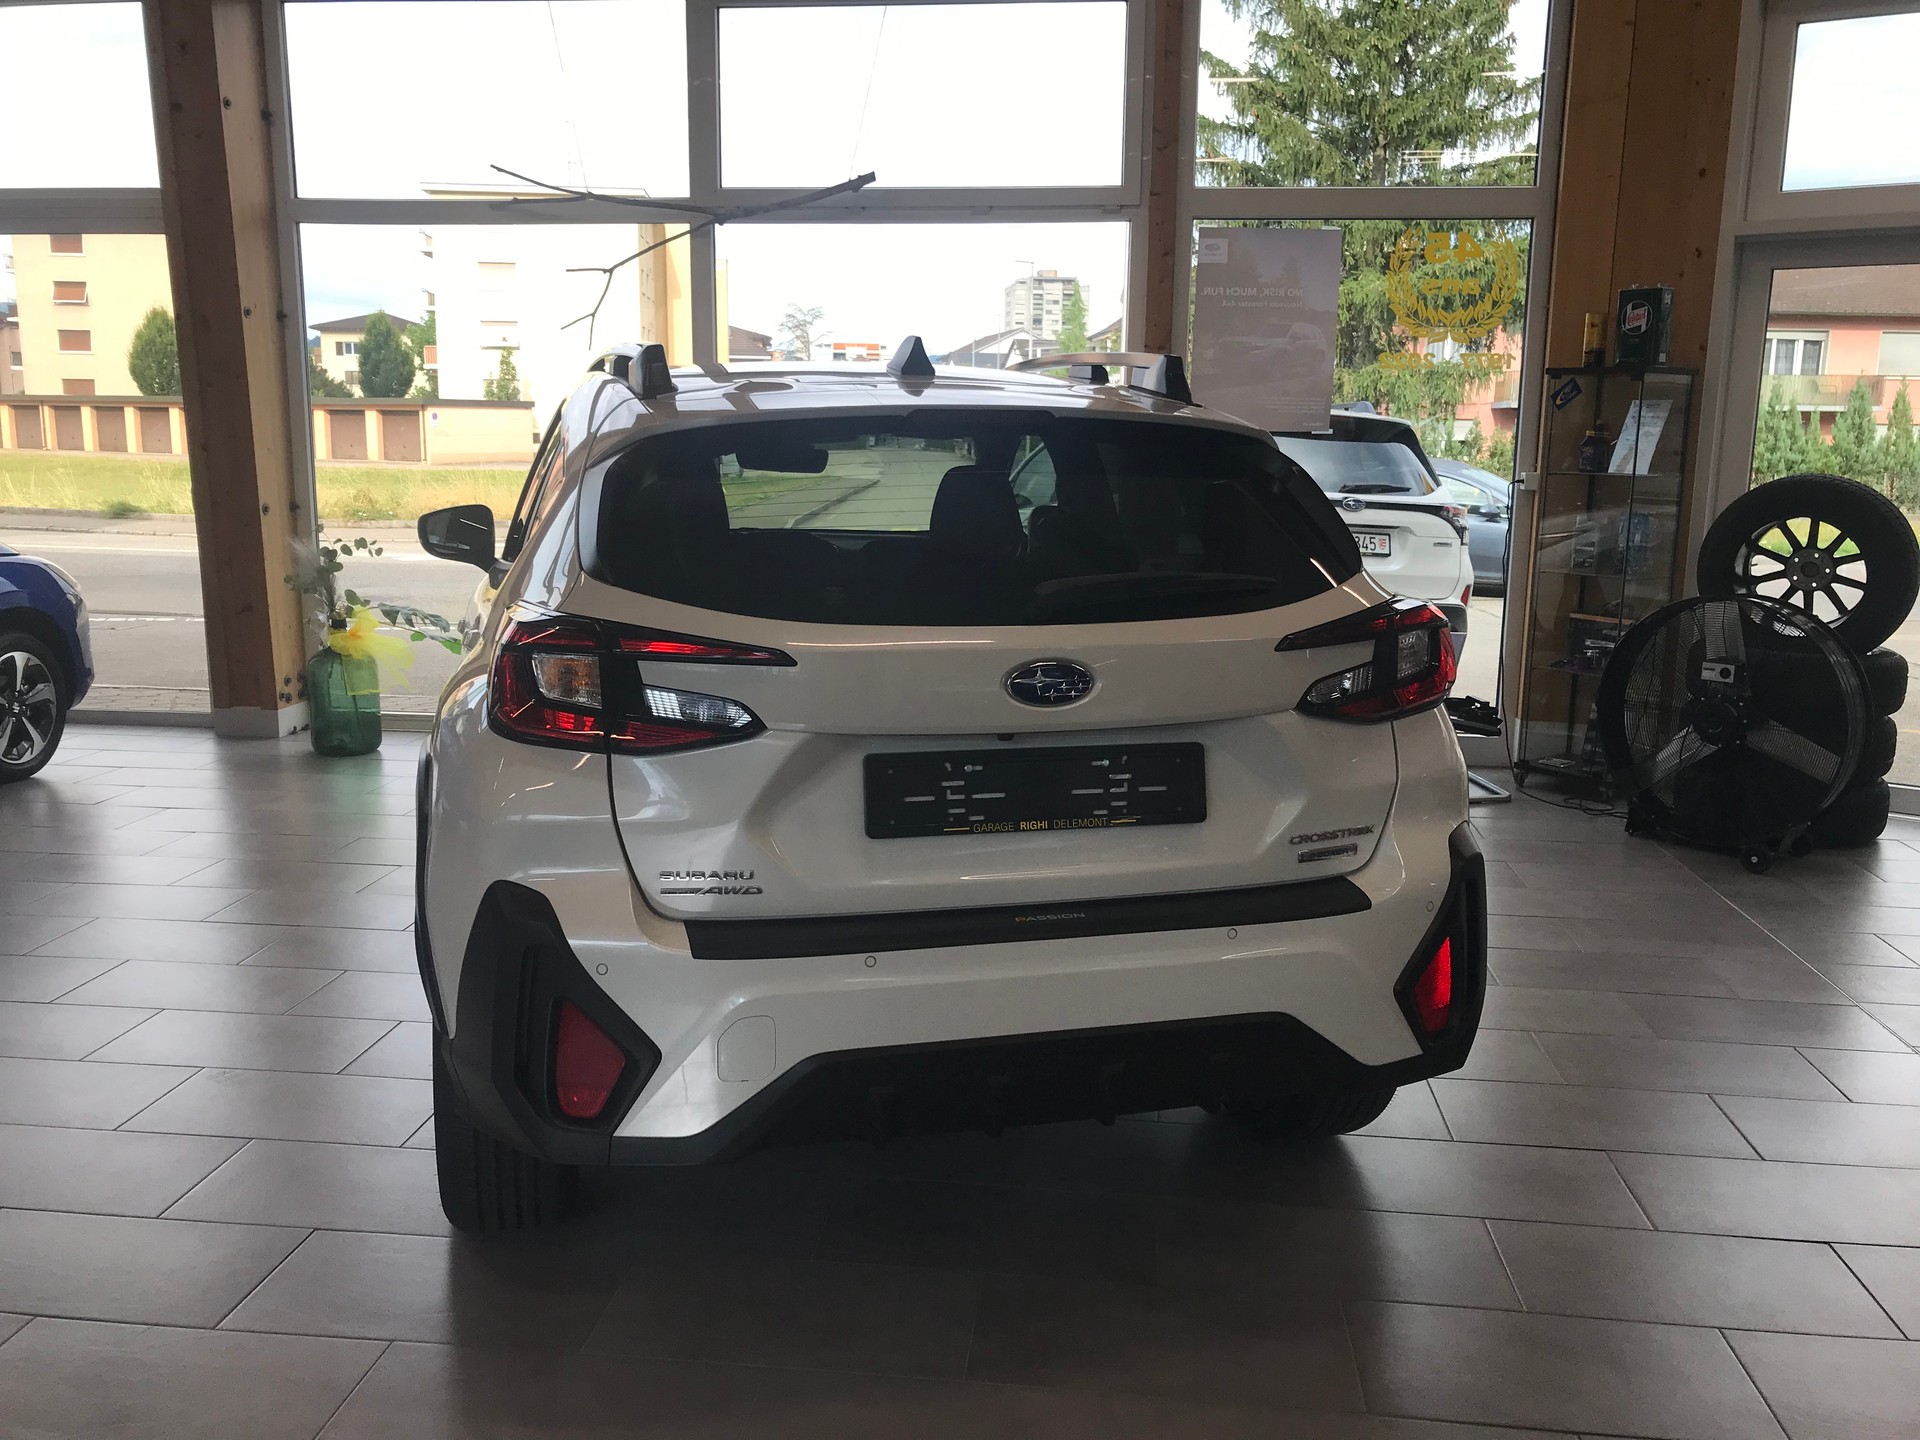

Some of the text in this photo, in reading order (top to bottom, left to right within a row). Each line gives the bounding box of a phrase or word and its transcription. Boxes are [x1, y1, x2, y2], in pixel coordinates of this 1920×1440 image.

[973, 817, 1108, 833] GARAGE RIGHI DELEMONT
[1288, 823, 1375, 845] CROSSTREK
[659, 870, 755, 882] SUBARU
[702, 886, 763, 896] AWD
[1014, 912, 1086, 923] PASSION
